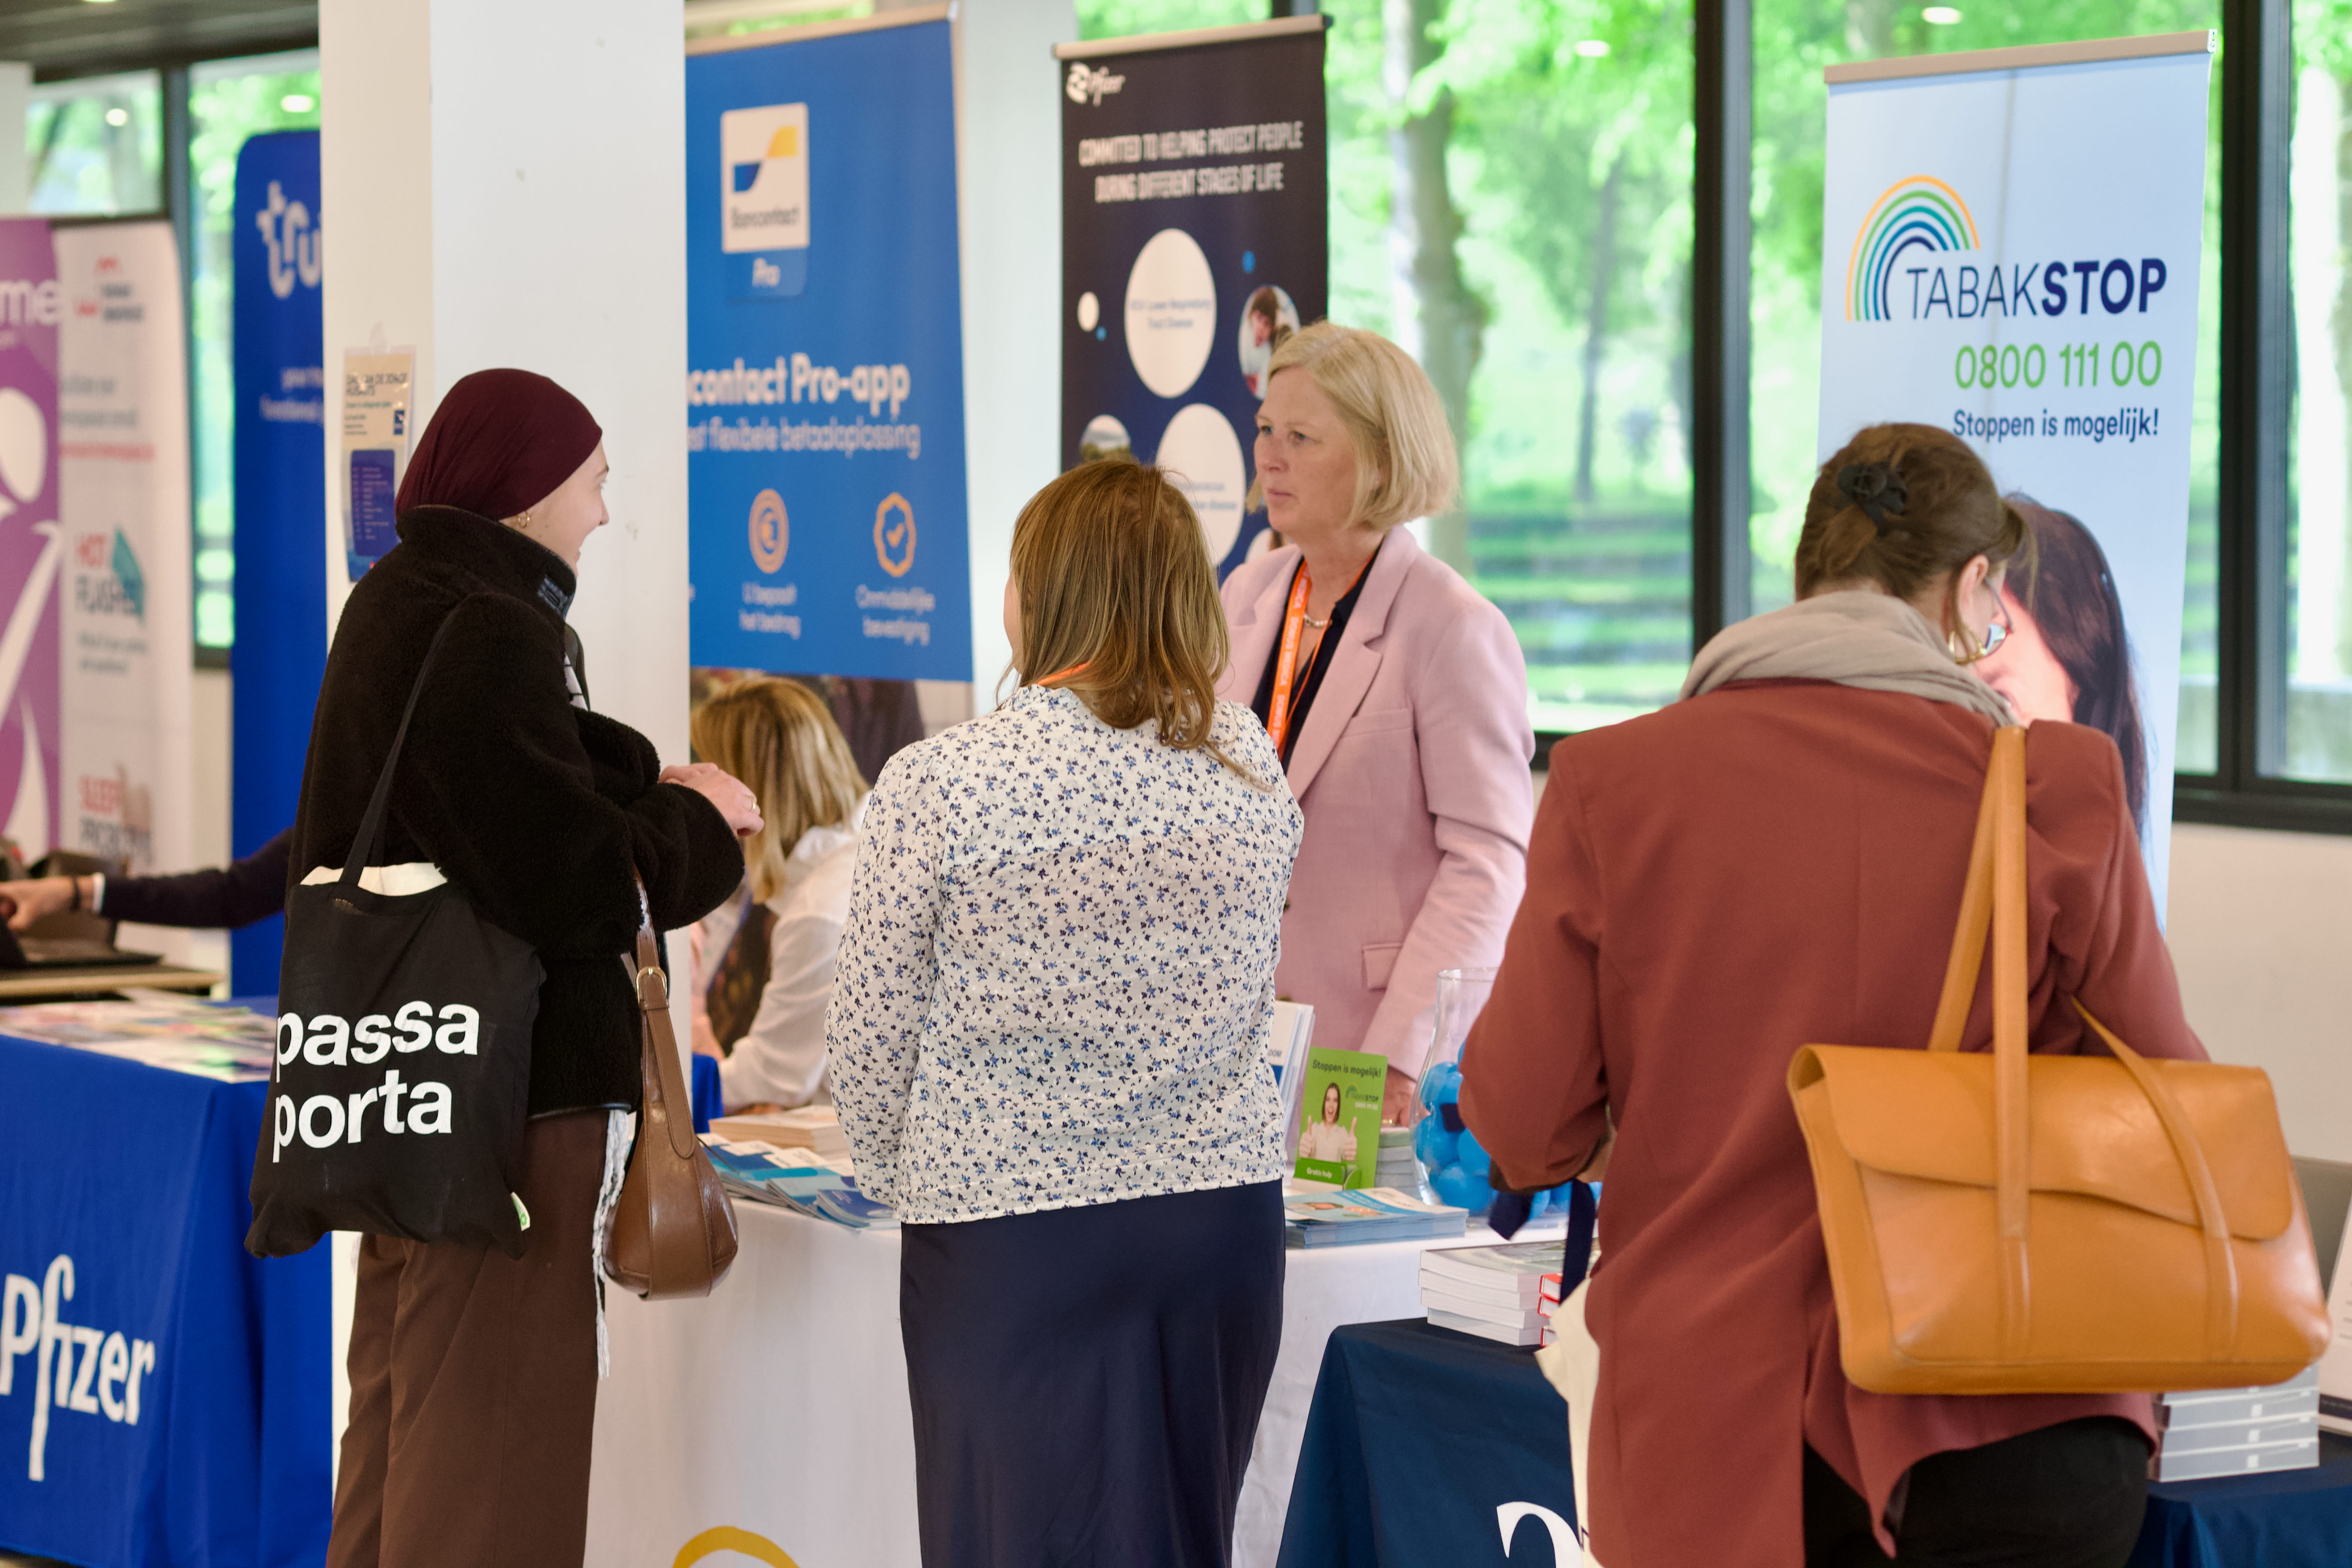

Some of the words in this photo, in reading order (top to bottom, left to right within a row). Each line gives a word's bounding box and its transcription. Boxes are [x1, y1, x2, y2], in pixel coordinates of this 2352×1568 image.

[1078, 134, 1142, 167] COMMITTED
[1143, 132, 1159, 161] TO
[1160, 130, 1206, 159] HELPING
[1207, 124, 1256, 155] PROTECT
[1257, 120, 1303, 151] PEOPLE
[1095, 172, 1136, 203] DURING
[1137, 168, 1196, 201] DIFFERENT
[1197, 166, 1239, 196] STAGES
[1240, 163, 1255, 193] OF
[1256, 162, 1284, 192] LIFE
[752, 257, 781, 287] Pro
[1906, 257, 2167, 321] TABAKSTOP
[688, 355, 787, 406] contact
[791, 352, 910, 419] Pro-app
[1955, 343, 2047, 389] 0800
[2059, 343, 2099, 387] 111
[2111, 341, 2162, 387] 00
[1953, 409, 2034, 442] Stoppen
[2042, 409, 2058, 435] is
[2065, 408, 2159, 443] mogelijk!
[276, 1000, 480, 1083] passa
[1313, 1059, 1342, 1072] Stoppen
[1343, 1064, 1348, 1073] is
[1350, 1066, 1382, 1079] mogelijk!
[273, 1069, 452, 1163] porta
[0, 1254, 155, 1481] Pfizer
